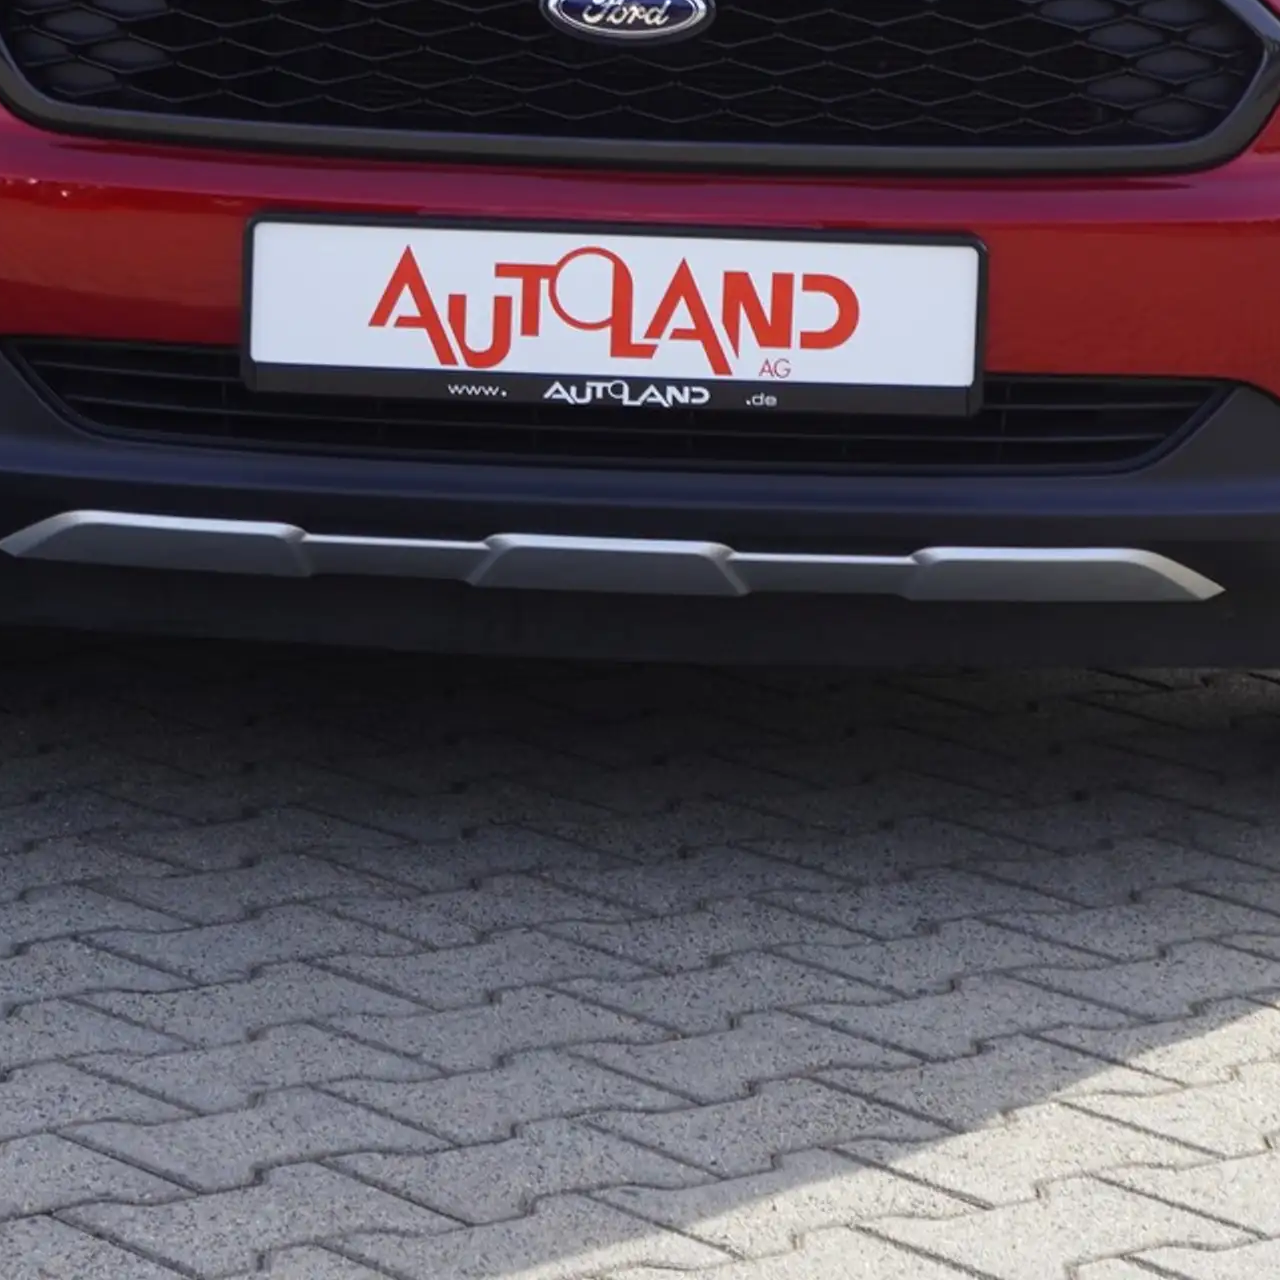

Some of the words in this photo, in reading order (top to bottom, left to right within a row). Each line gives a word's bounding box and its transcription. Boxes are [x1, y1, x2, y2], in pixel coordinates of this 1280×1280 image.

[368, 243, 861, 376] AUTOLAND
[758, 358, 792, 379] AG
[447, 383, 508, 398] www.
[543, 379, 711, 408] AUTOLAND
[744, 392, 778, 407] .de
